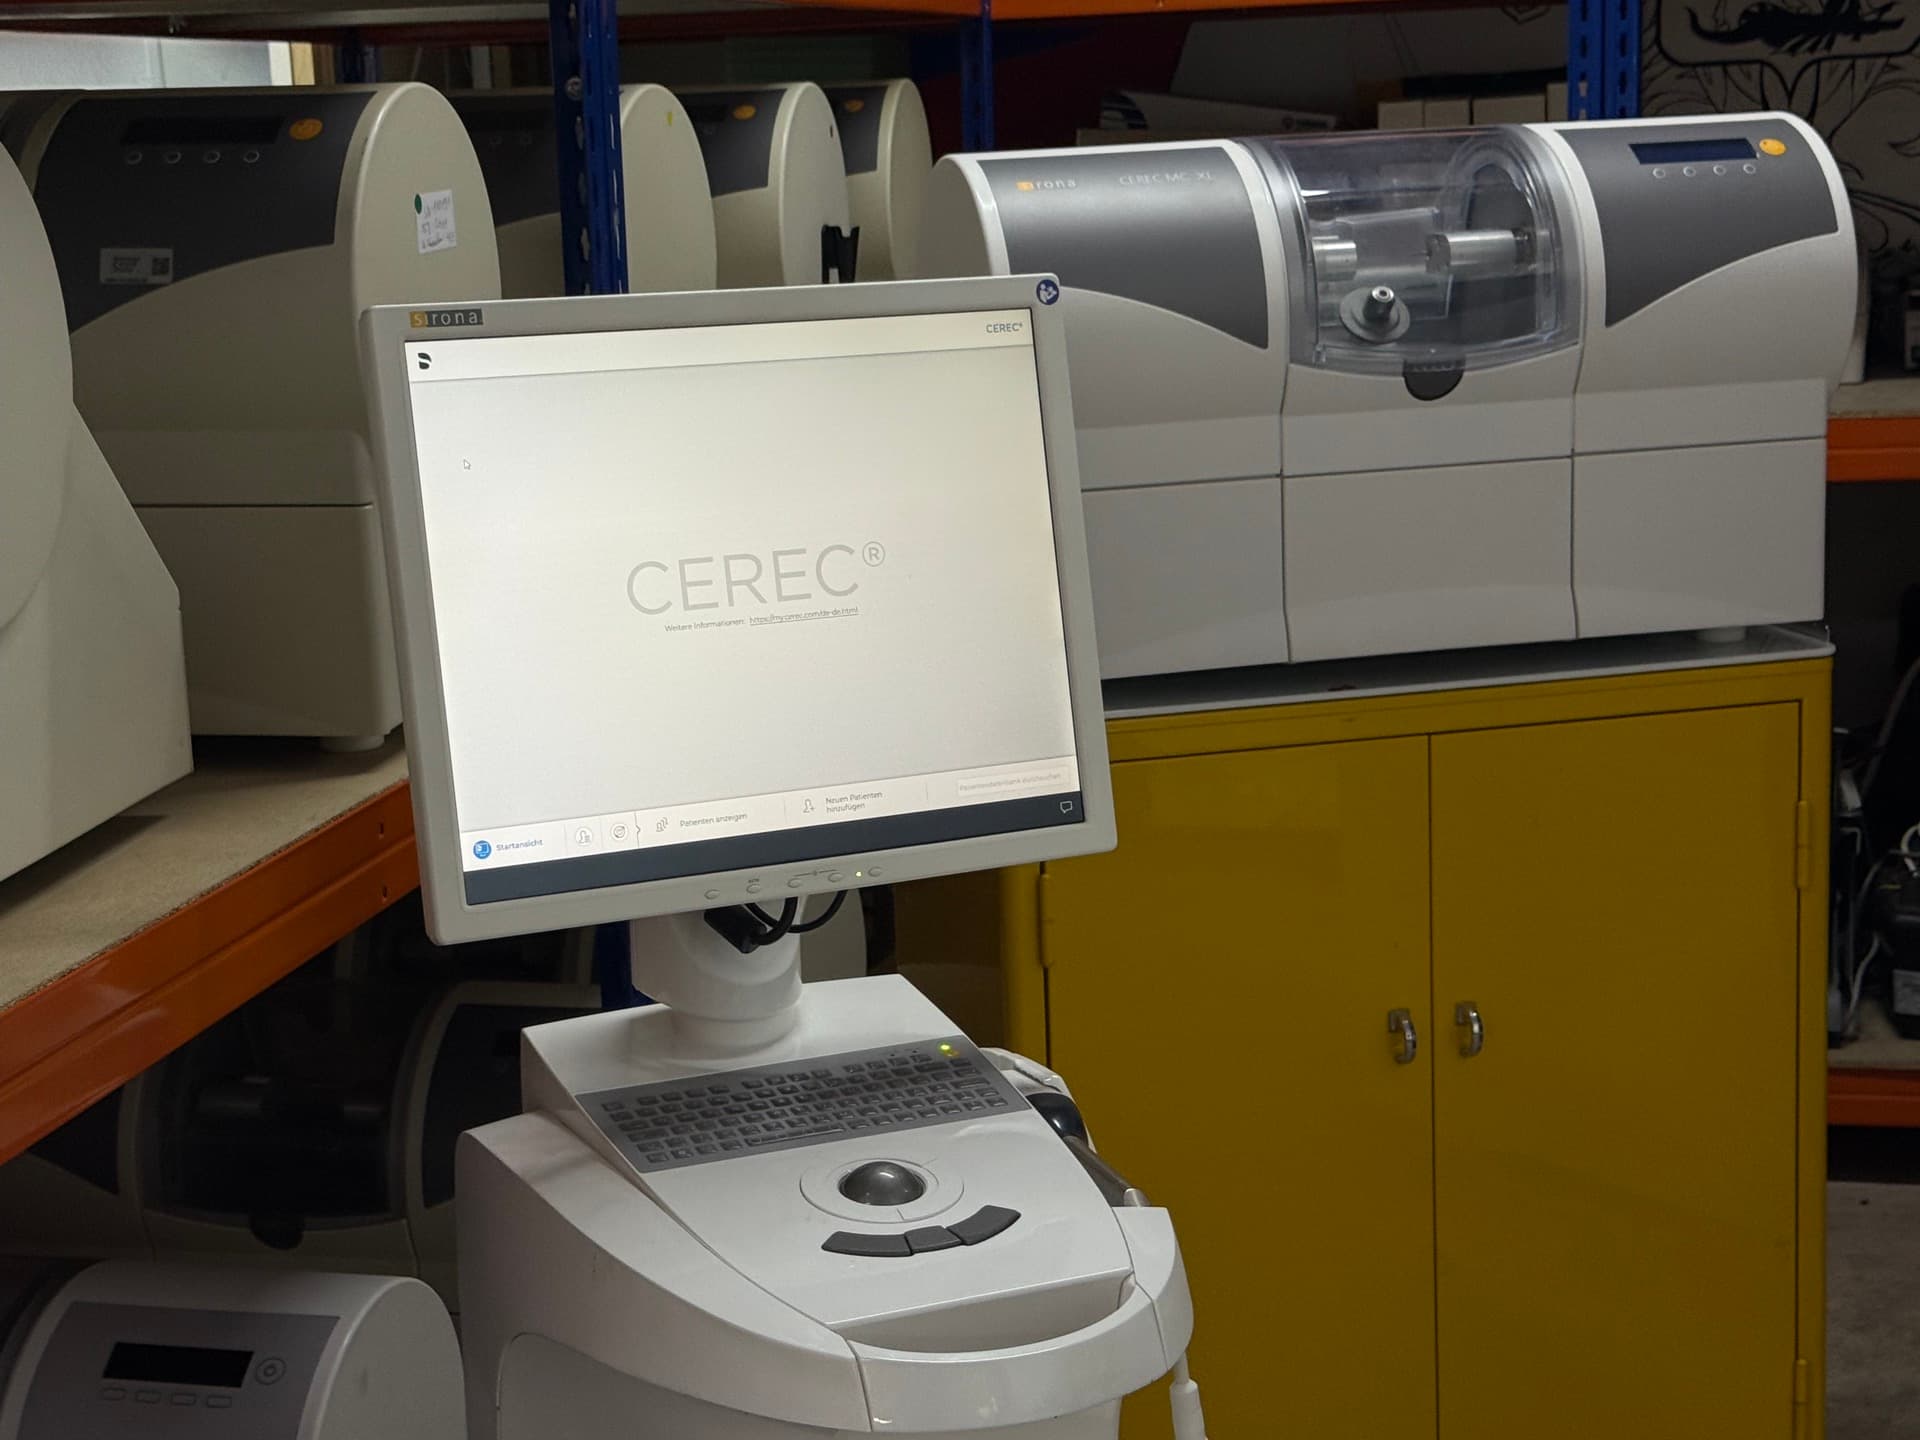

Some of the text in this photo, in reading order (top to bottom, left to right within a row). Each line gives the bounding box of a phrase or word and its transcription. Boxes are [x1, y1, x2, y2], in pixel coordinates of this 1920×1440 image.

[412, 311, 480, 327] sirona
[664, 623, 693, 633] Weitere
[825, 791, 883, 805] Neuen Patienten
[826, 802, 866, 814] hinzufügen
[679, 816, 714, 828] Patienten
[495, 839, 544, 852] Startansicht
